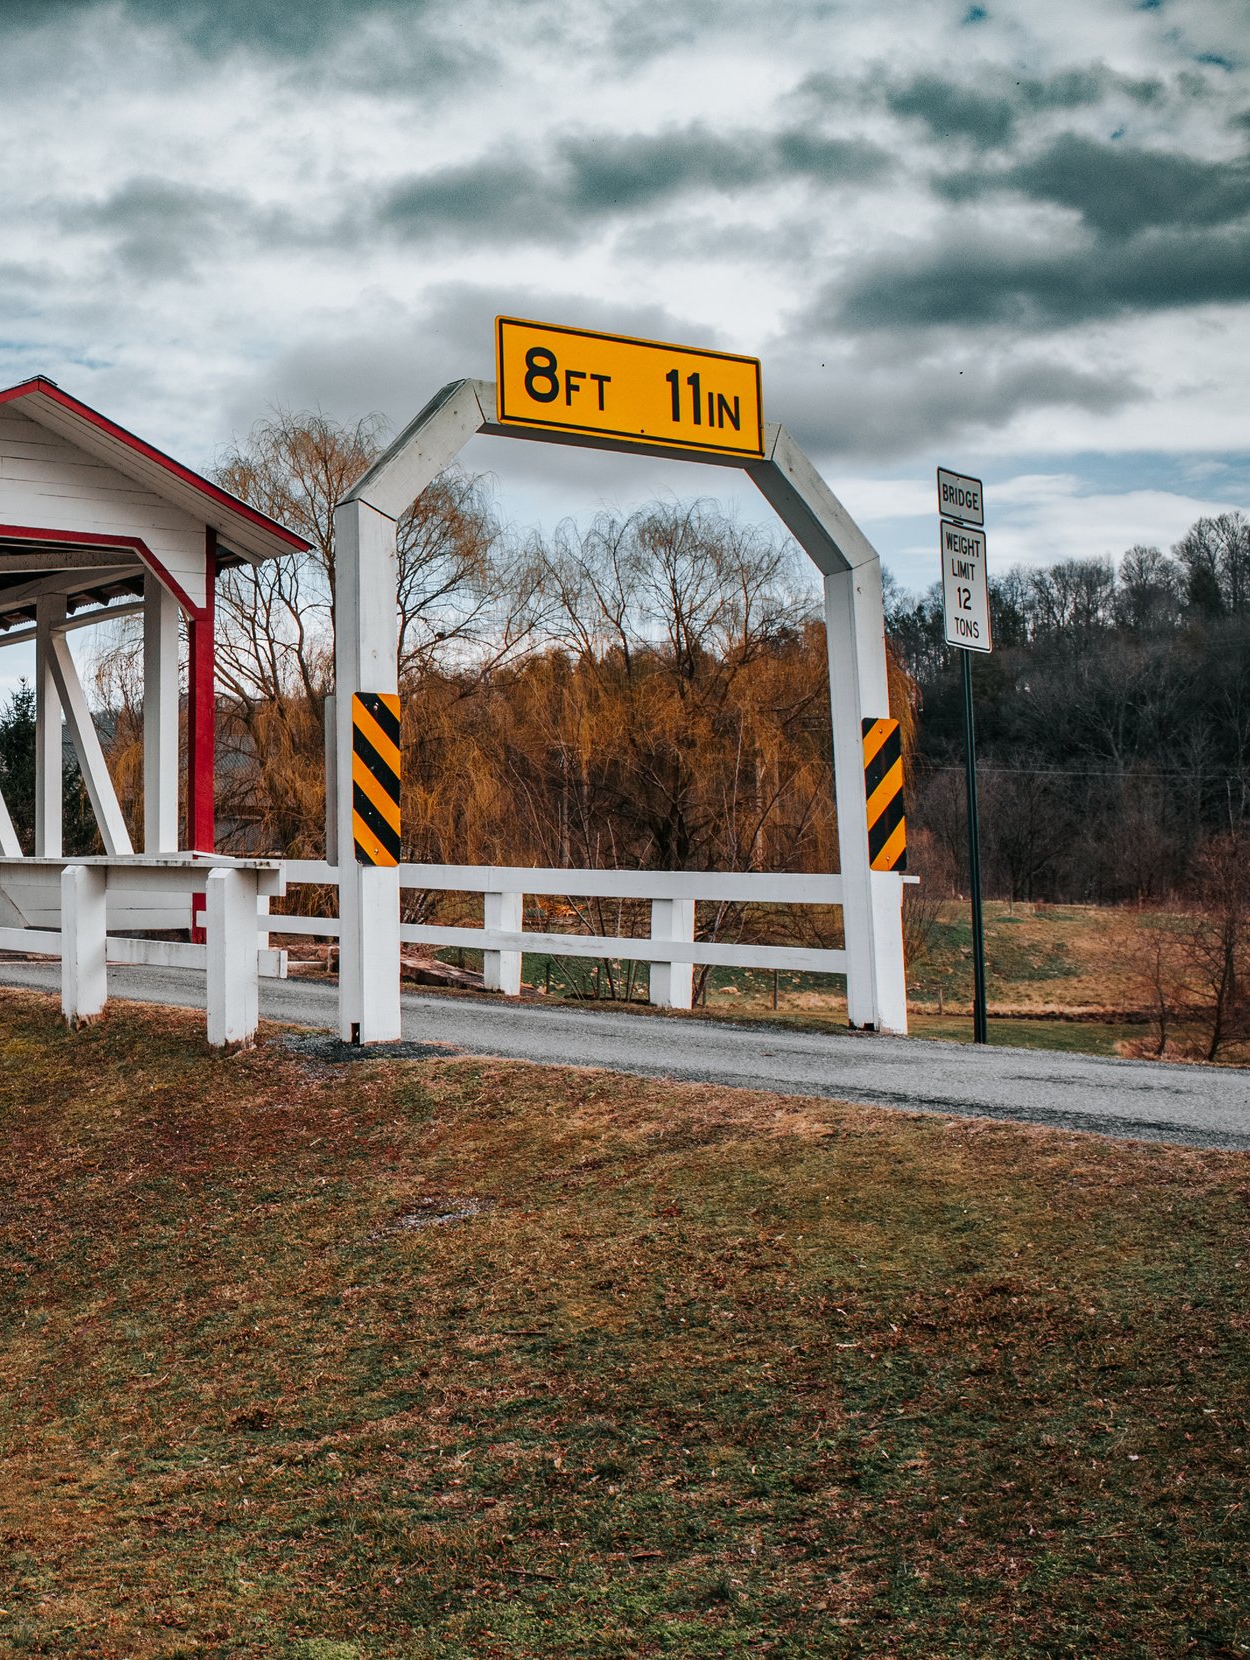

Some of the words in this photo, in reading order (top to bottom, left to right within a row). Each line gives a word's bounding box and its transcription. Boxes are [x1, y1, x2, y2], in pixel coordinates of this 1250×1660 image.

[942, 483, 979, 511] BRIDGE
[946, 531, 980, 558] WEIGHT
[951, 558, 976, 581] LIMIT
[957, 586, 972, 610] 12
[954, 616, 979, 639] TONS
